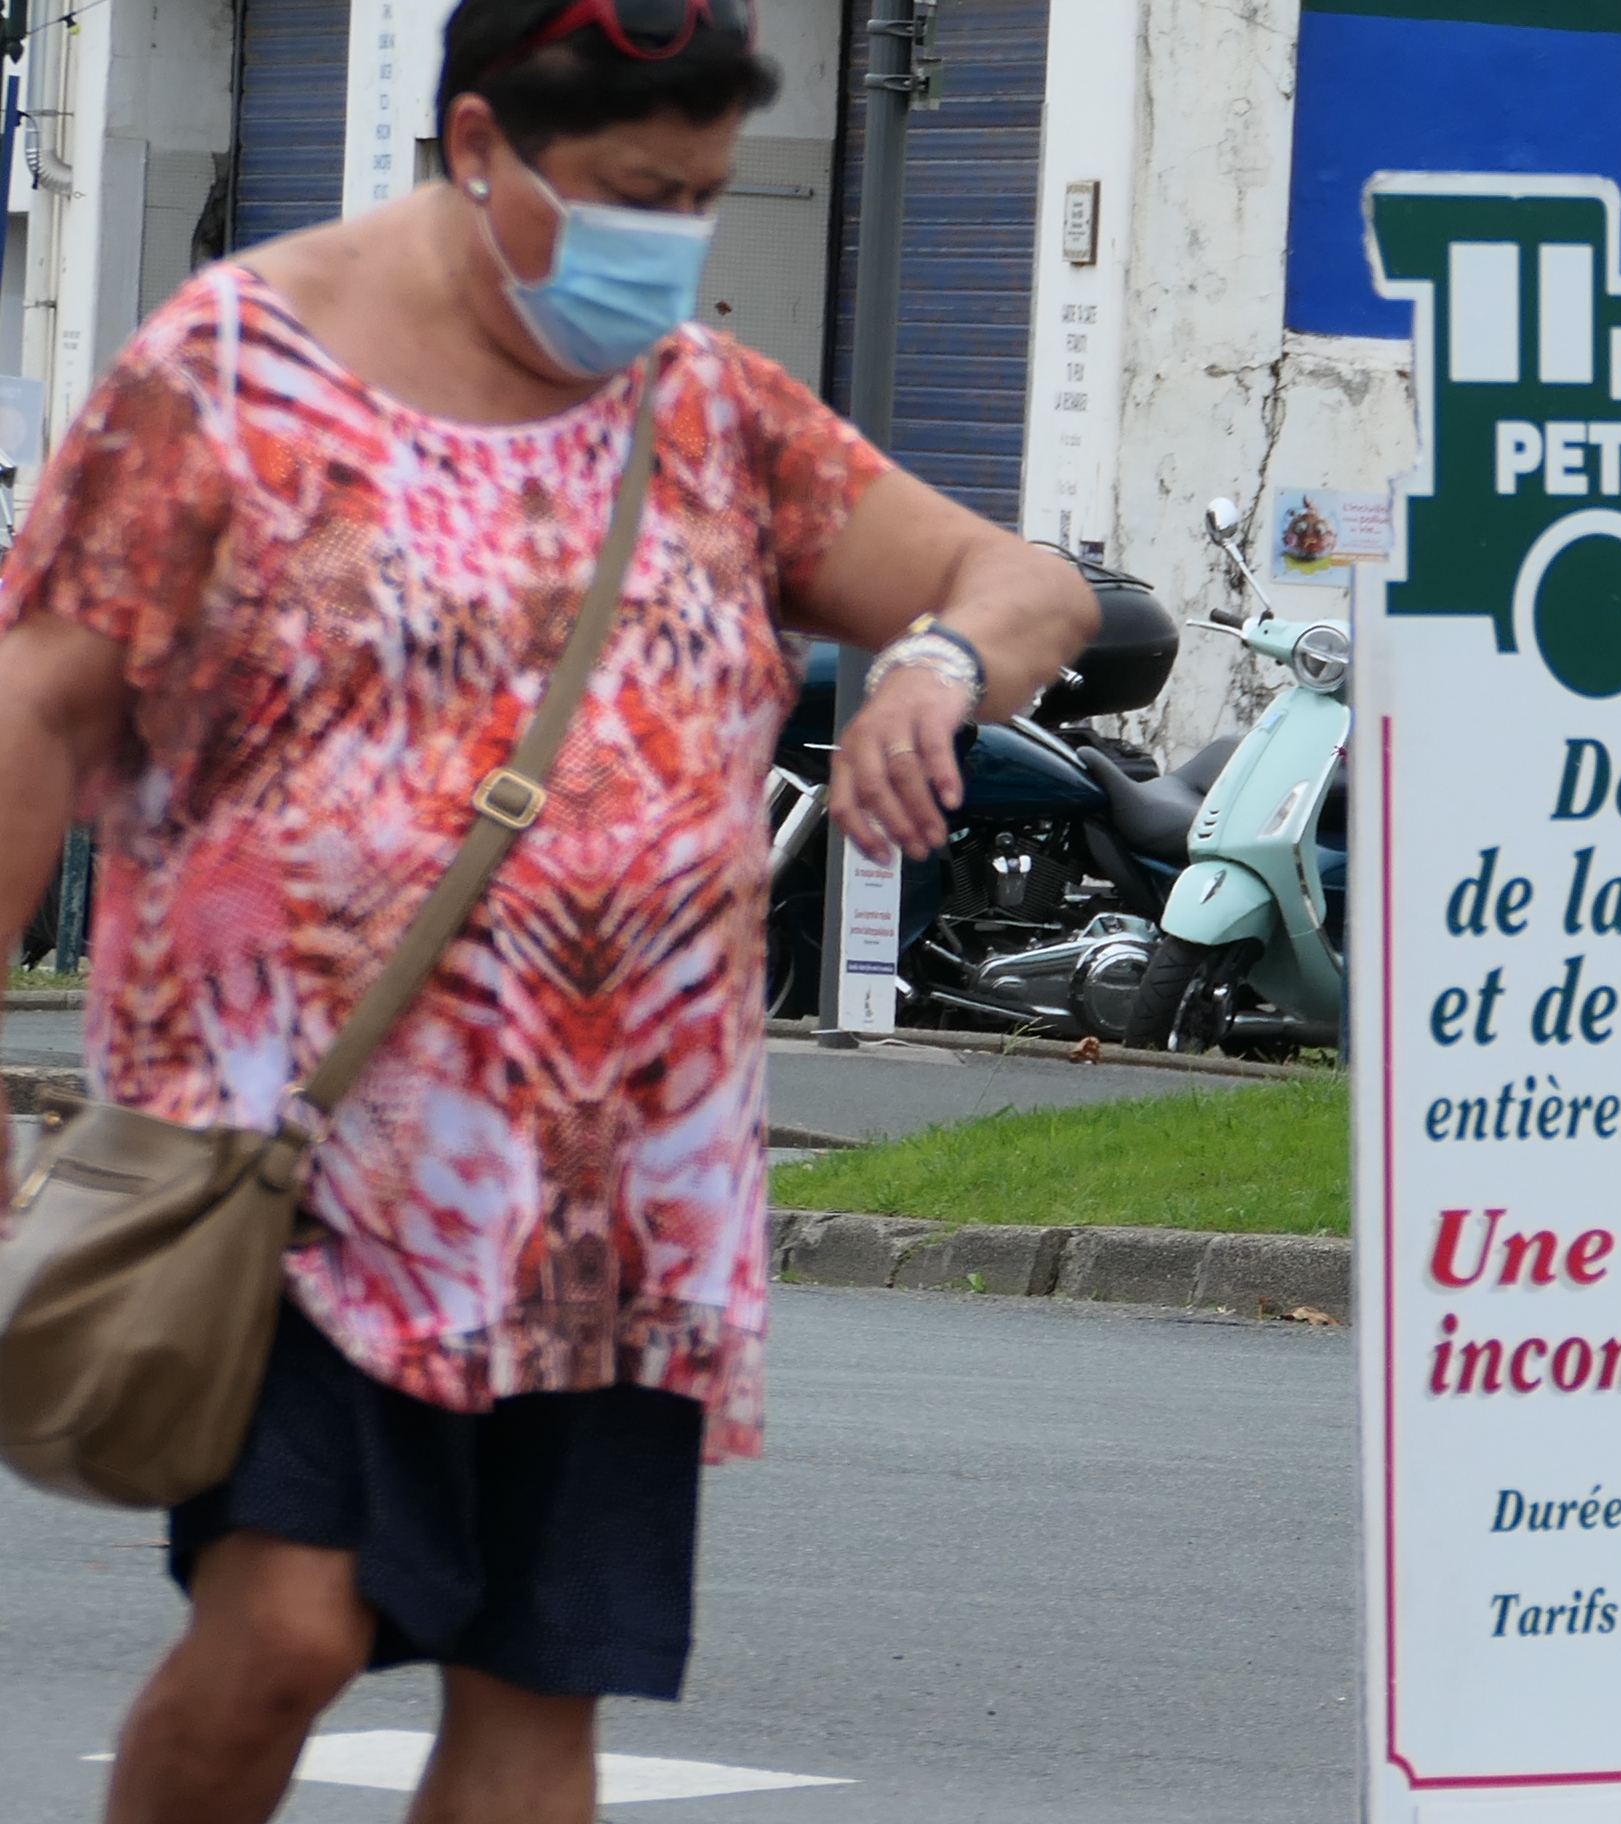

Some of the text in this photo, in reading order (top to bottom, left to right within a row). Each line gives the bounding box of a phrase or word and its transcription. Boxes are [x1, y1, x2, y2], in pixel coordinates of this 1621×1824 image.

[1445, 845, 1534, 938] de
[1429, 966, 1506, 1047] et
[1530, 954, 1618, 1046] de
[1430, 1208, 1614, 1289] Une
[1491, 1586, 1619, 1638] Tarifs
